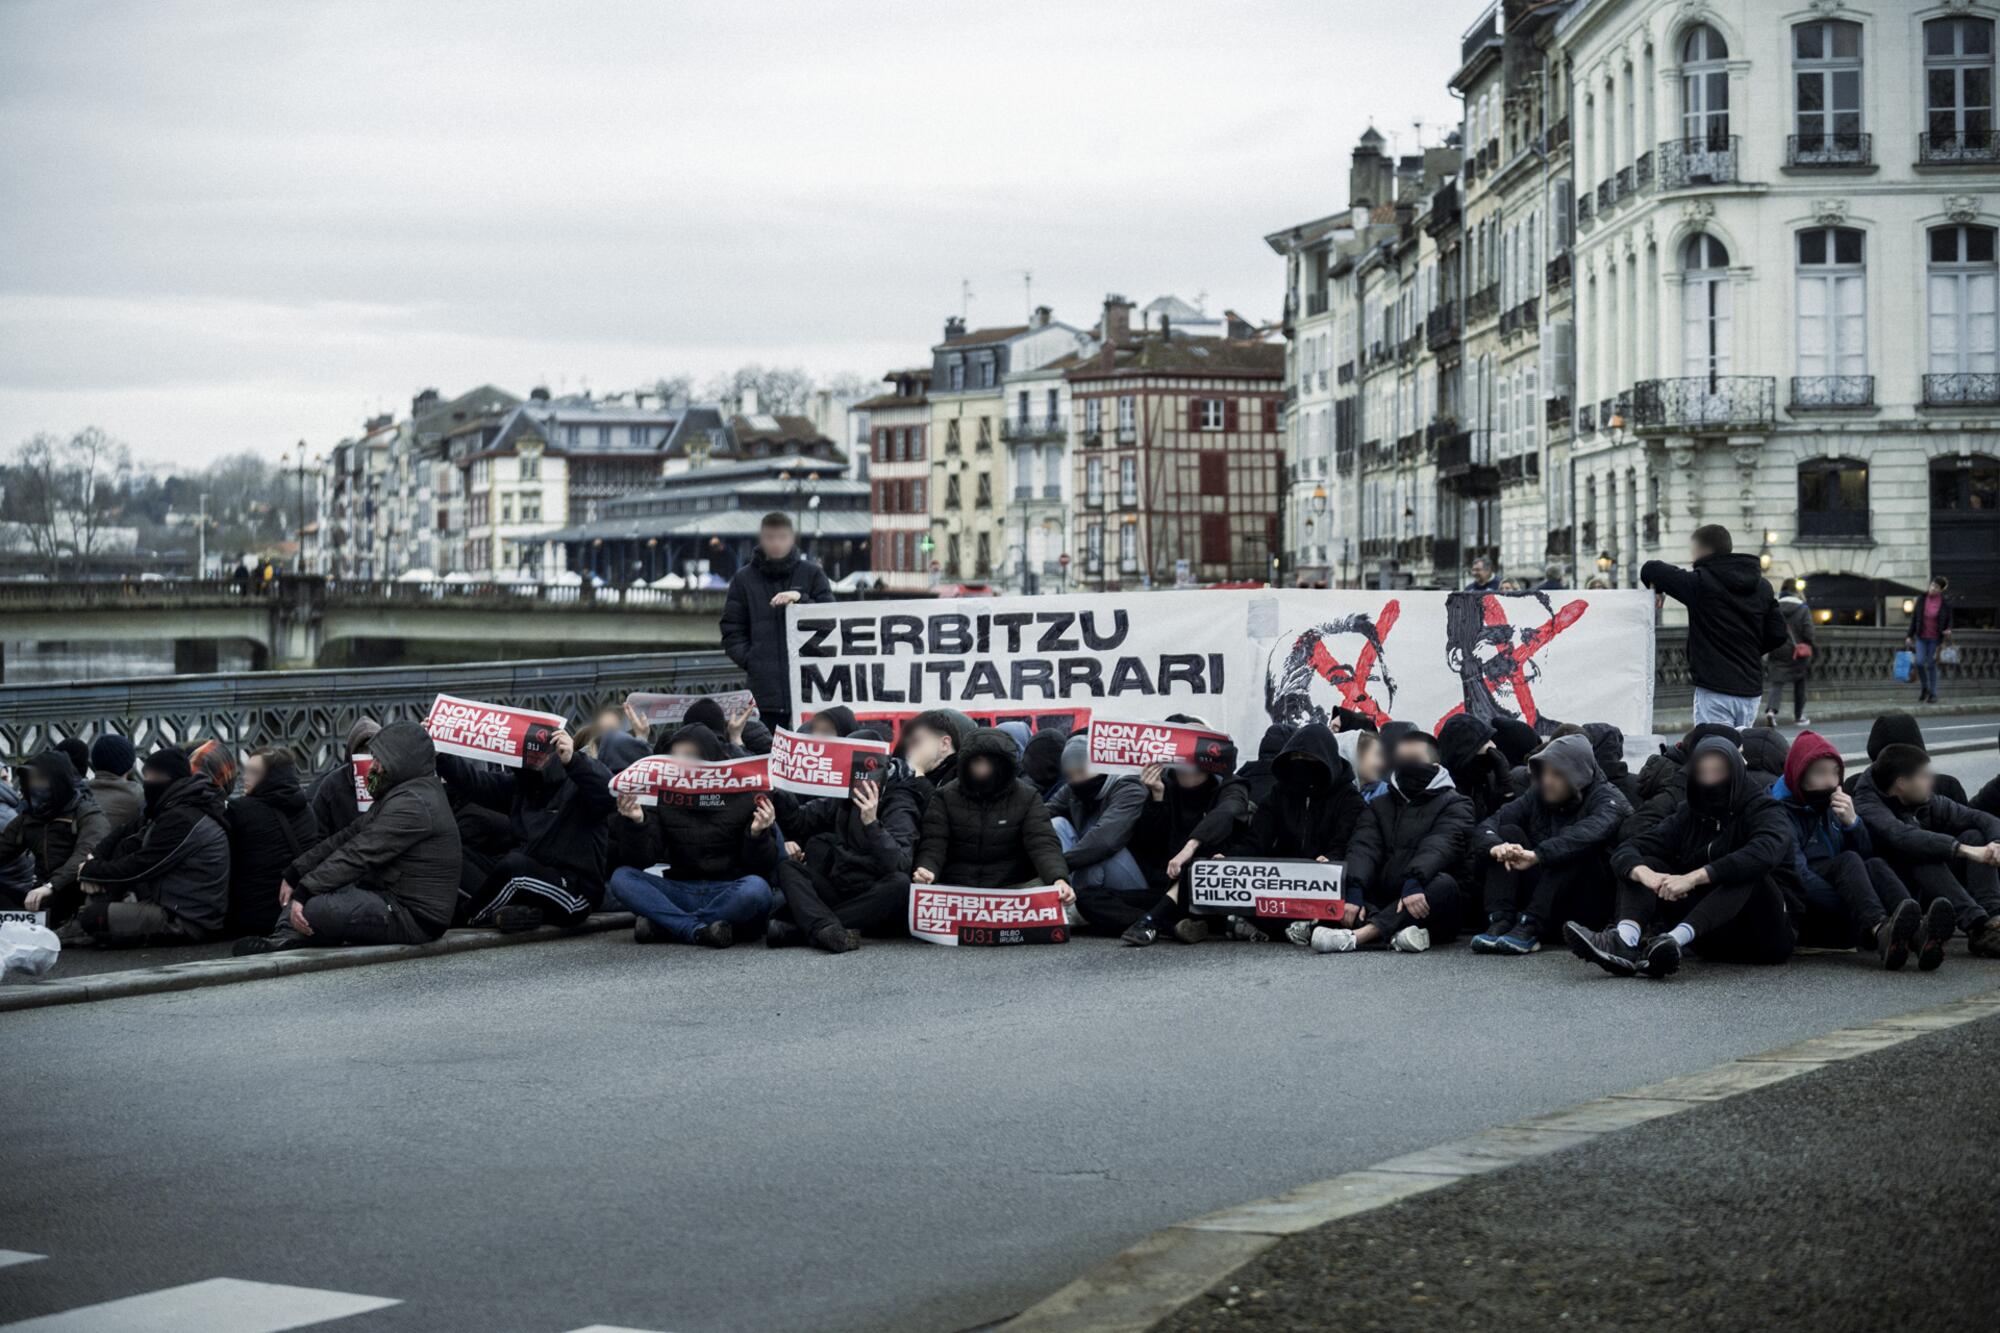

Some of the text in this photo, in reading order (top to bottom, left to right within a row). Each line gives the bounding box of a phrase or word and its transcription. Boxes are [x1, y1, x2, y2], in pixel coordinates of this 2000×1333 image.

[796, 608, 1129, 657] ZERBITZU
[800, 653, 1224, 703] MILITARRARI
[437, 702, 510, 725] NON AU
[432, 714, 512, 738] SERVICE
[1094, 724, 1138, 738] NON
[1140, 728, 1172, 742] AU
[428, 724, 517, 754] MILITAIRE
[772, 733, 825, 756] NON AU
[1093, 737, 1177, 755] SERVICE
[771, 746, 833, 771] SERVICE
[630, 761, 733, 779] ZERBITZU
[770, 759, 843, 784] MILITAIRE
[617, 782, 651, 793] EZ!
[620, 771, 763, 789] MILITARRARI
[663, 792, 694, 806] U31
[1194, 864, 1280, 877] EZ GARA
[1194, 877, 1338, 892] ZUEN GERRAN
[918, 892, 1031, 910] ZERBITZU
[1195, 890, 1252, 902] HILKO
[917, 906, 1058, 922] MILITARRARI
[1258, 900, 1288, 914] U31
[917, 919, 951, 932] EZ!
[963, 929, 994, 943] U31
